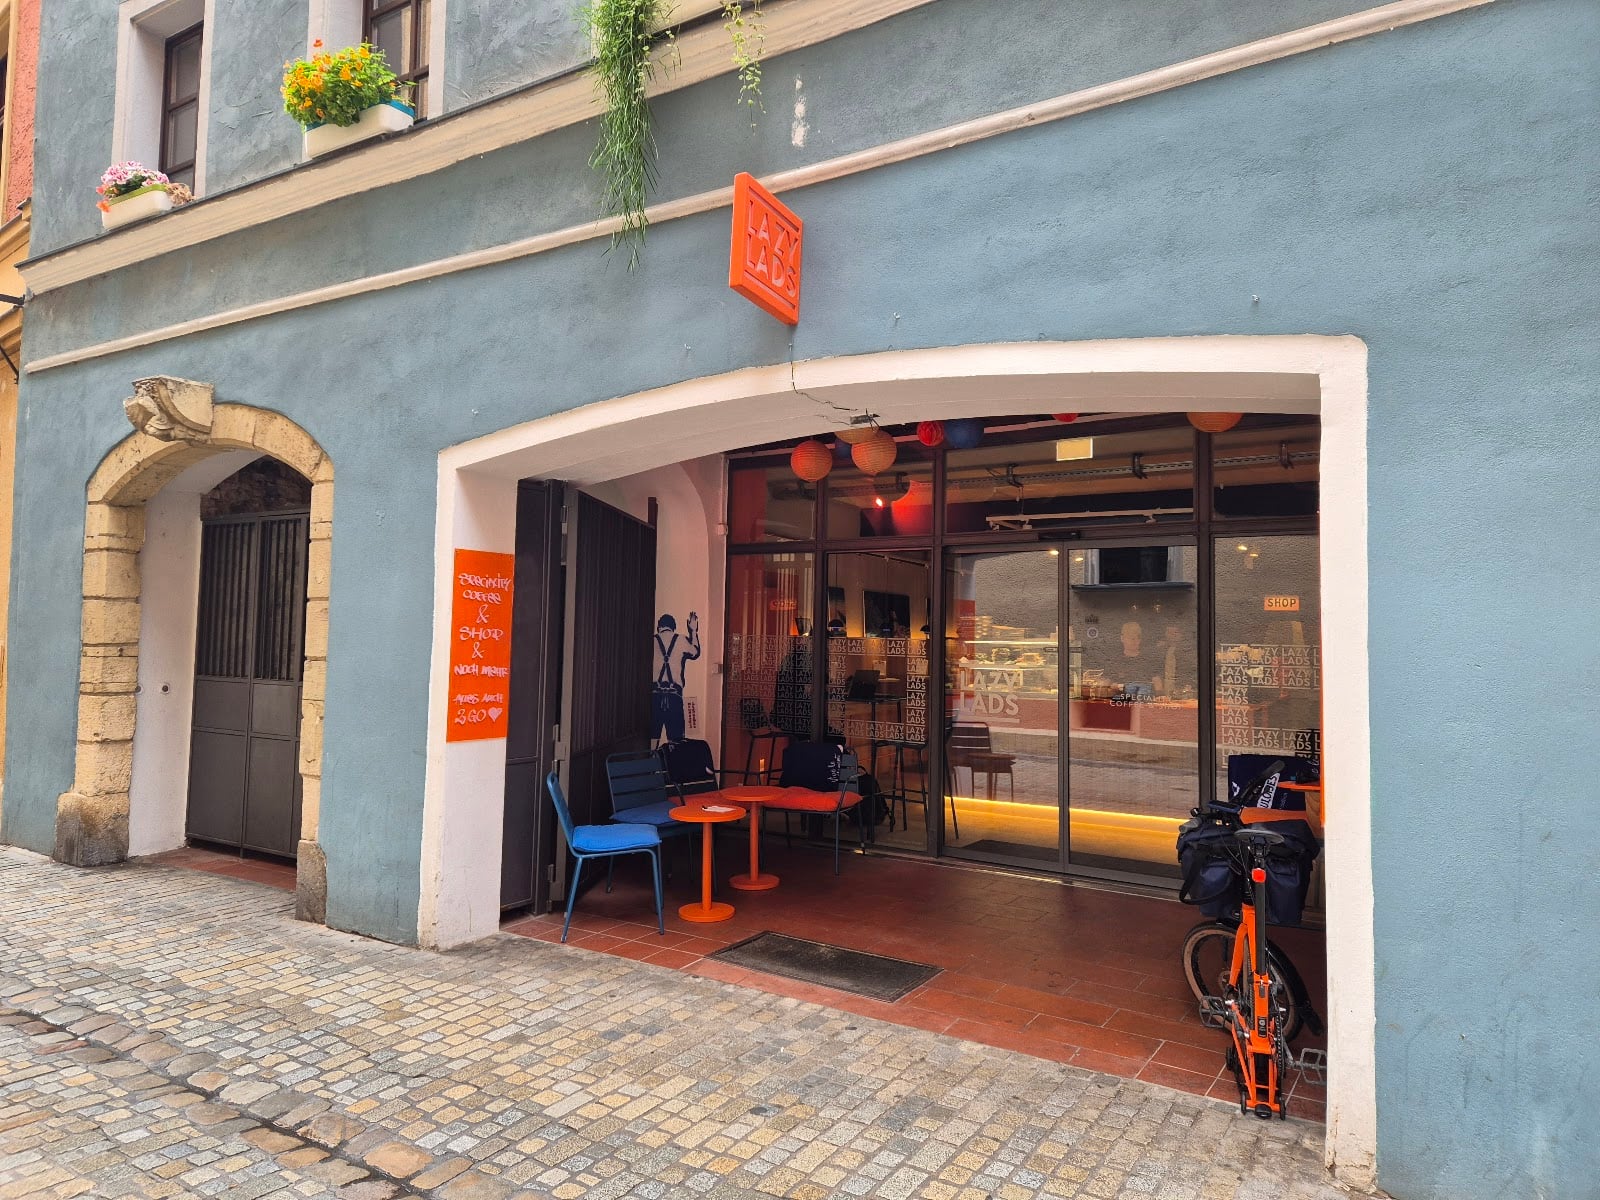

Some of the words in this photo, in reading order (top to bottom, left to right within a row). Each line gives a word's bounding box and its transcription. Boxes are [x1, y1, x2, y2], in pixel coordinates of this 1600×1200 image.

[749, 200, 798, 264] LAZY
[746, 233, 797, 298] LADS
[1267, 598, 1296, 608] SHOP
[476, 604, 490, 624] &
[459, 626, 504, 640] SHOP
[472, 642, 486, 658] &
[1282, 648, 1310, 656] LAZY
[1282, 669, 1310, 678] LAZY
[961, 670, 1019, 692] LAZY
[1251, 677, 1278, 685] LADS
[1282, 678, 1310, 686] LADS
[1222, 687, 1248, 696] LAZY
[961, 692, 1019, 716] LADS
[1222, 708, 1248, 716] LAZY
[1222, 717, 1248, 725] LADS
[886, 724, 904, 732] LAZY
[906, 726, 924, 734] LAZY
[1222, 728, 1248, 737] LAZY
[1252, 730, 1279, 739] LAZY
[1283, 732, 1311, 741] LAZY
[1222, 737, 1248, 746] LADS
[1253, 740, 1279, 748] LADS
[1283, 742, 1311, 750] LADS
